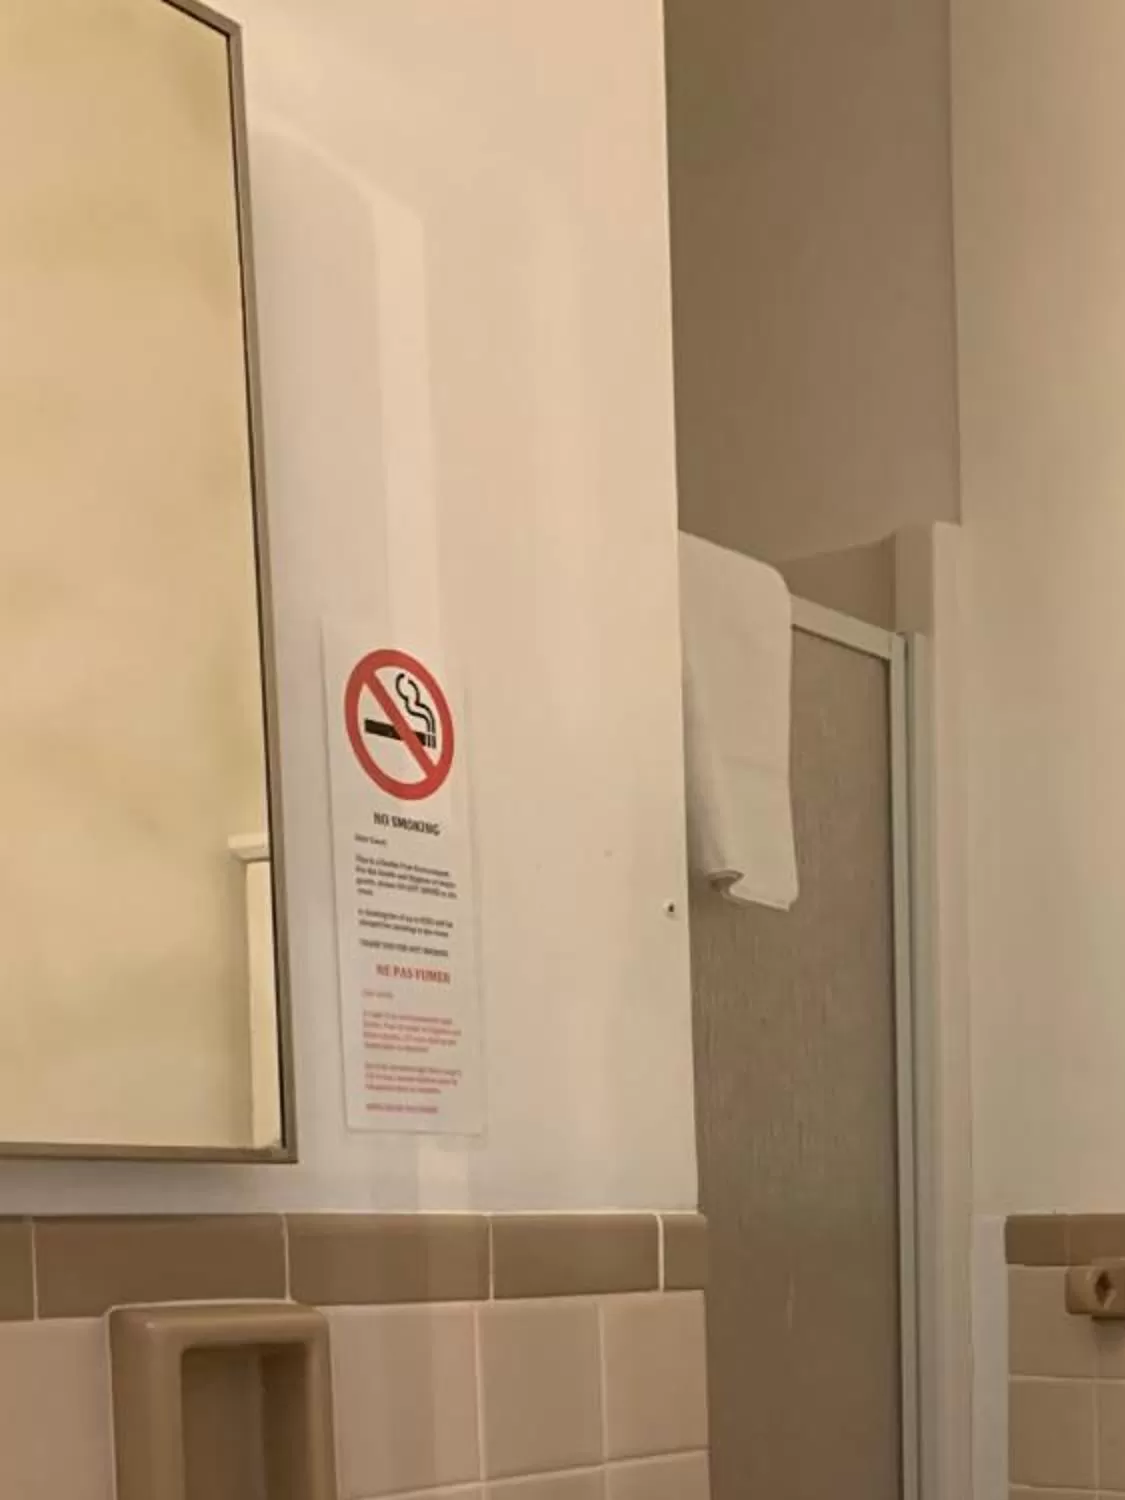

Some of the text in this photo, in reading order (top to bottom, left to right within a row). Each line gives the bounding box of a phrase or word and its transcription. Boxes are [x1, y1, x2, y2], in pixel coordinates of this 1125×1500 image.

[373, 812, 440, 836] NO SMOKING
[393, 965, 413, 980] PAS
